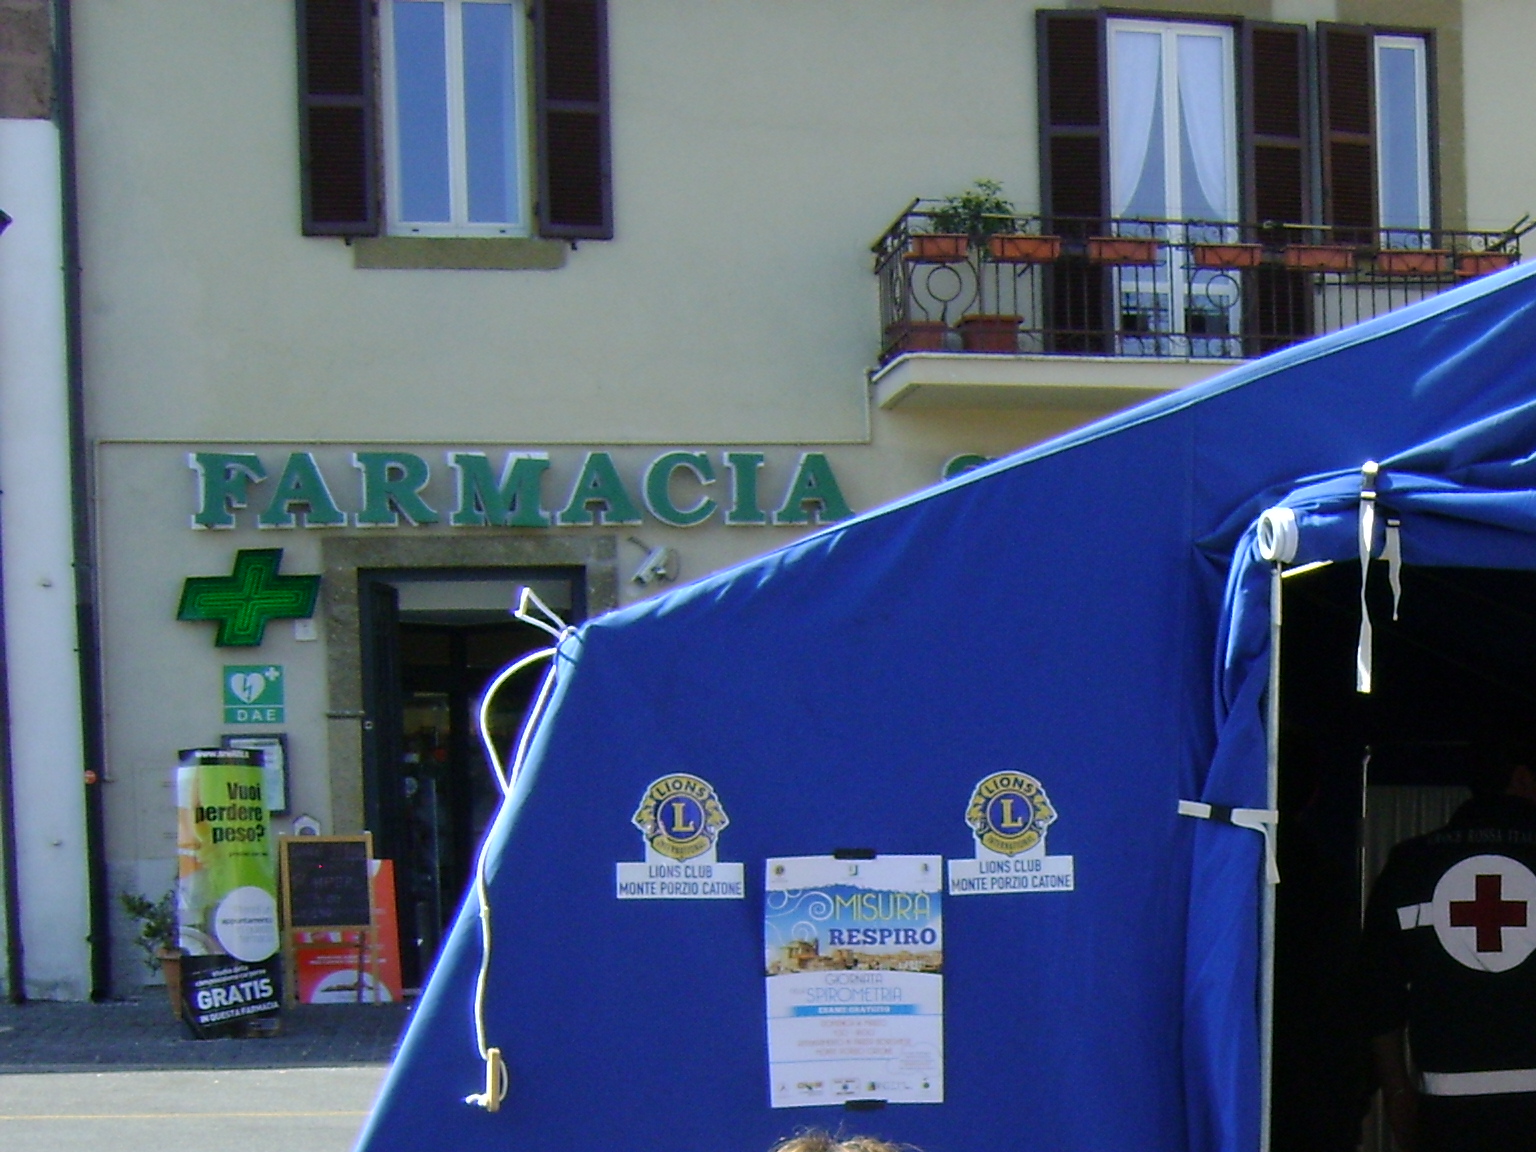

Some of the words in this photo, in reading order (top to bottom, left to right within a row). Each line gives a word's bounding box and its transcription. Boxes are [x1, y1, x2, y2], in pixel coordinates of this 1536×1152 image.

[188, 451, 856, 529] FARMACIA
[236, 709, 277, 721] DAE
[227, 782, 262, 801] Vuoi
[655, 779, 707, 798] LIONS
[984, 777, 1034, 795] LIONS
[195, 804, 263, 823] perdere
[671, 802, 695, 832] L
[1000, 799, 1023, 828] L
[212, 824, 265, 844] peso?
[648, 865, 681, 879] LIONS
[684, 865, 713, 879] CLUB
[979, 861, 1011, 875] LIONS
[1014, 859, 1042, 873] CLUB
[620, 881, 656, 895] MONTE
[660, 881, 699, 895] PORZIO
[702, 881, 742, 895] CATONE
[951, 877, 988, 892] MONTE
[990, 875, 1028, 890] PORZIO
[1031, 874, 1071, 889] CATONE
[829, 928, 937, 945] RESPIRO
[825, 973, 884, 986] GIORNATA
[197, 978, 275, 1011] GRATIS
[807, 987, 902, 1002] SPIROMETRIA
[241, 1001, 280, 1016] FARMACIA
